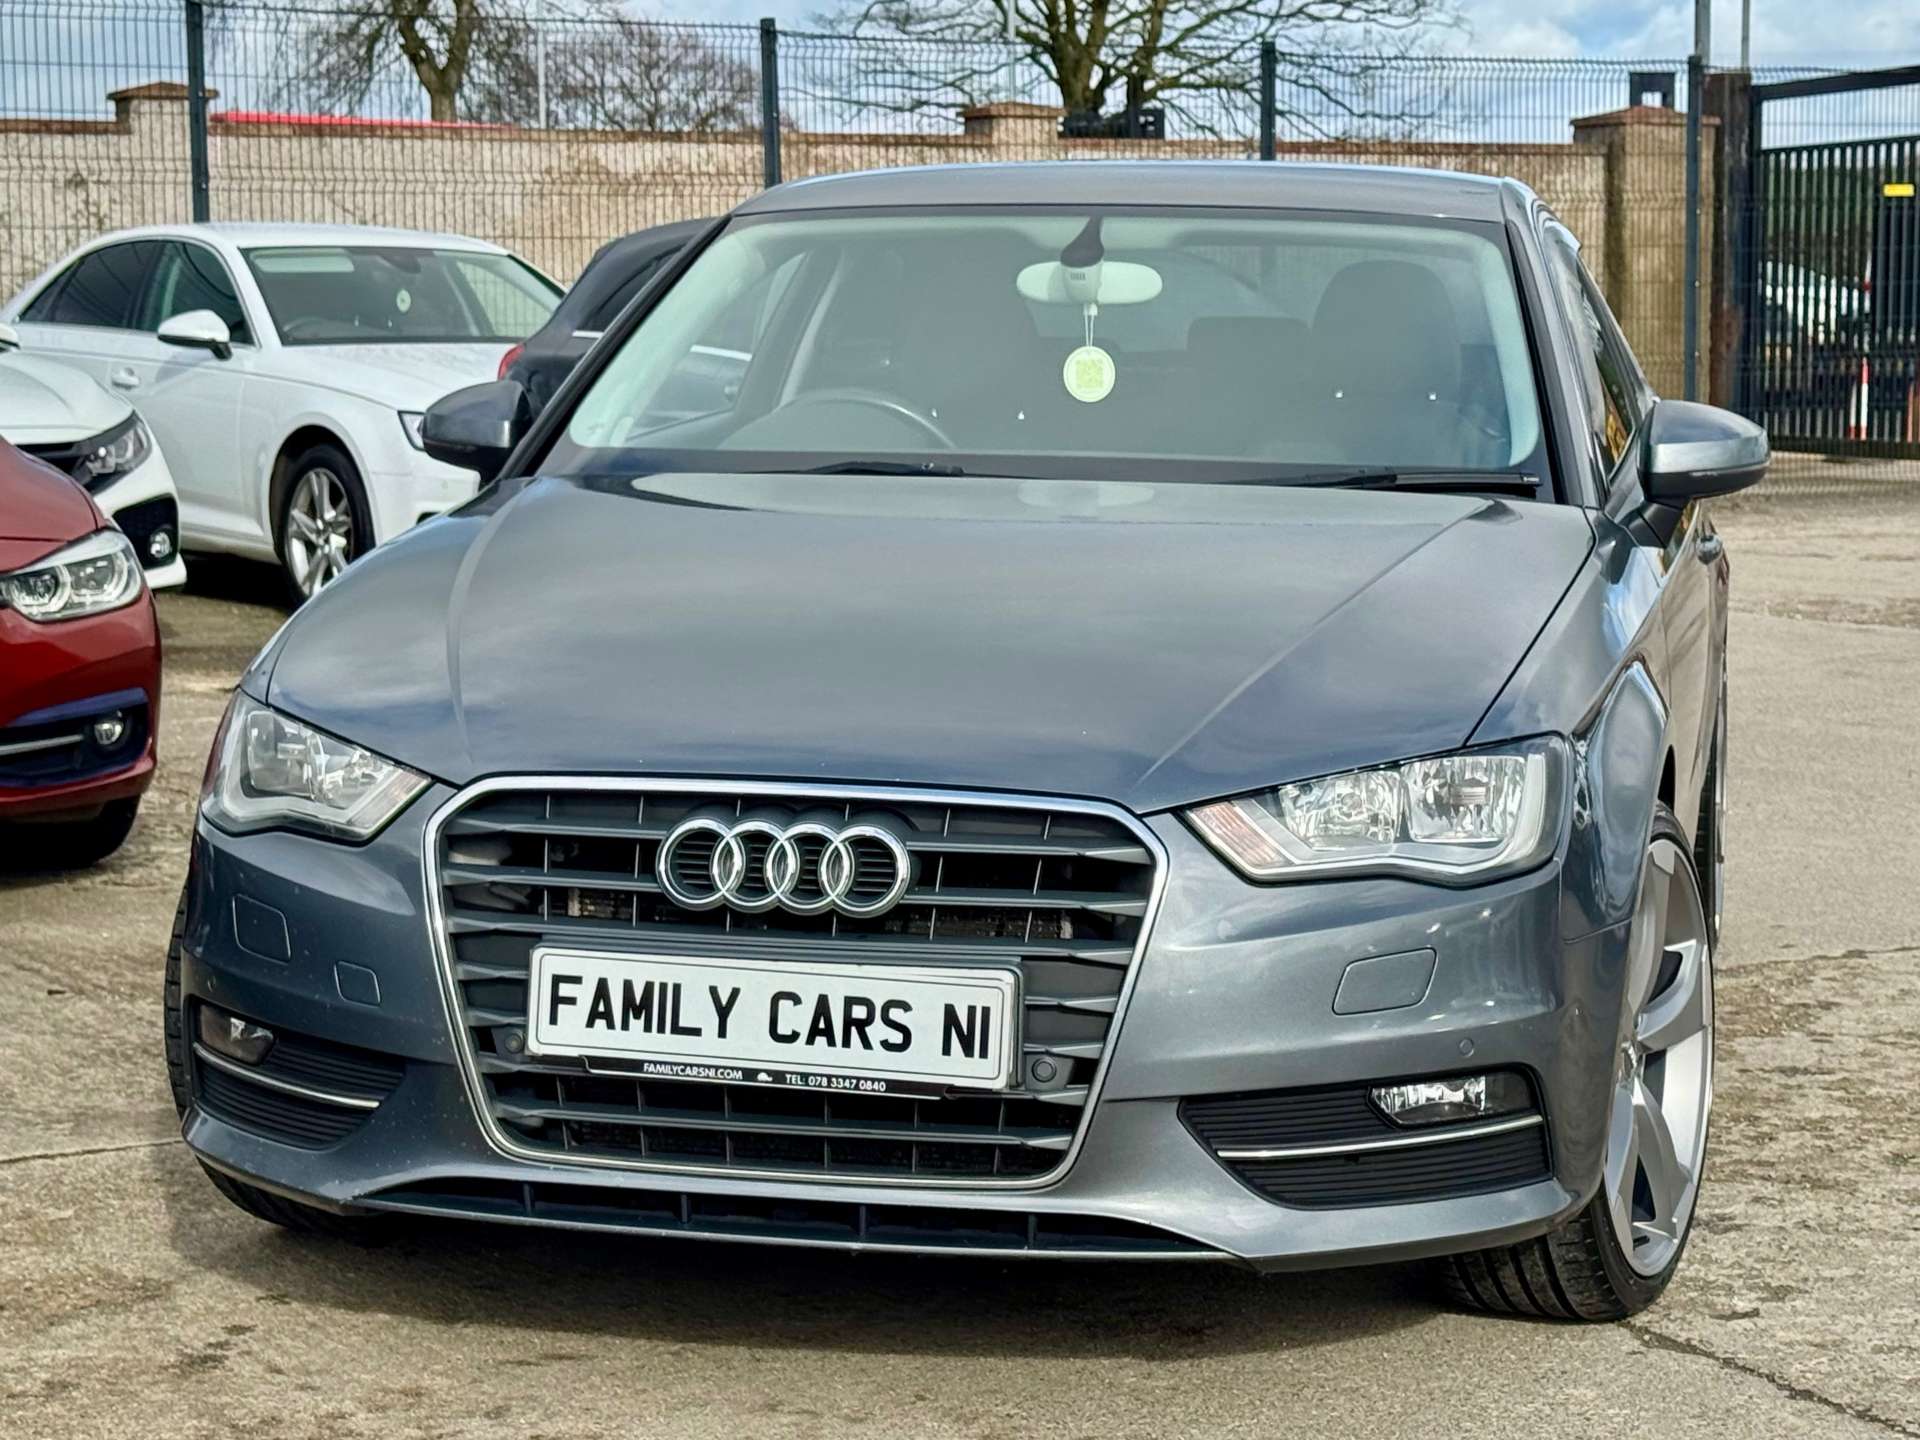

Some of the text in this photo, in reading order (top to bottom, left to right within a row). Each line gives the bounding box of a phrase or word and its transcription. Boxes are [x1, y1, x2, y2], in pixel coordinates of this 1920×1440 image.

[549, 974, 992, 1060] FAMILY CARS NI
[643, 1062, 887, 1093] FAMILYCARSNI.COM TEL: 078 3347 0840
